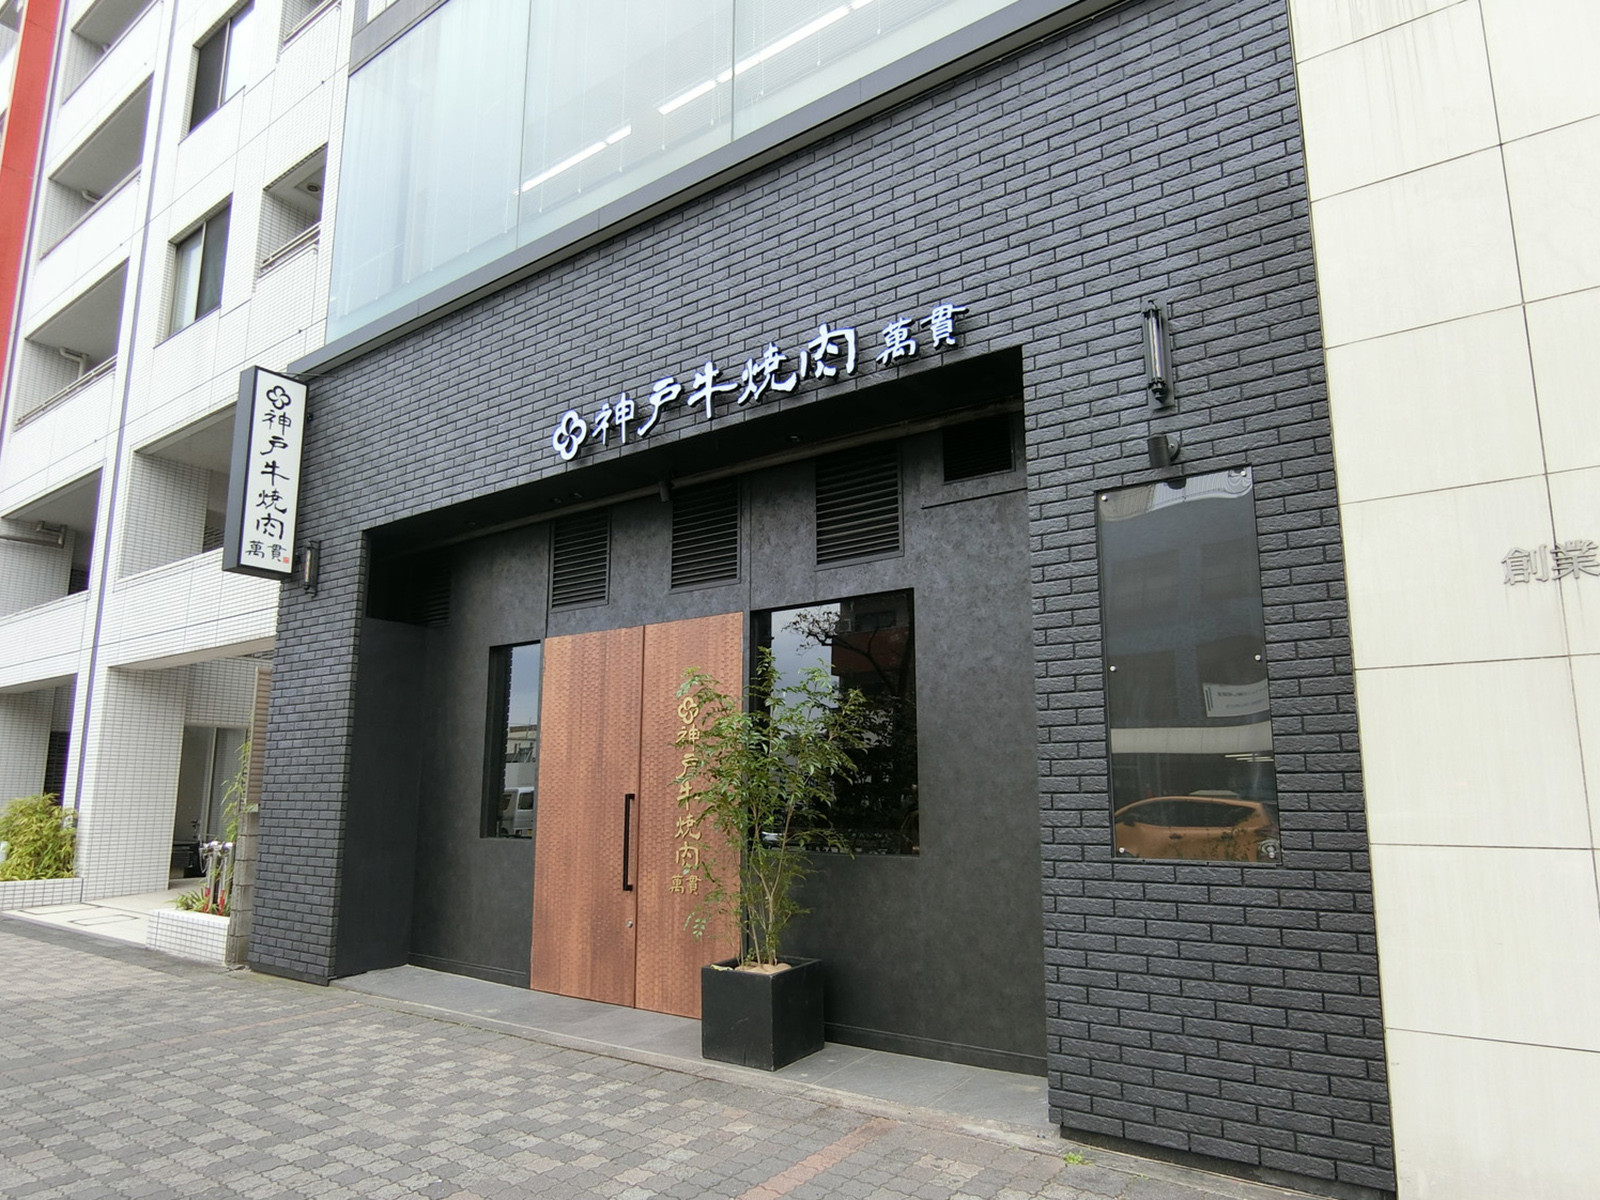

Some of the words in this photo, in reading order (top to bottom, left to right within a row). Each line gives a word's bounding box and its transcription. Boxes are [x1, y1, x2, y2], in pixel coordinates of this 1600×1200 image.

[591, 322, 857, 445] 神戸牛焼肉
[876, 303, 969, 366] 萬貫
[255, 410, 292, 540] 神戸牛焼肉
[245, 540, 288, 562] 萬貫
[1500, 540, 1600, 586] 創業
[674, 724, 702, 871] 神戸牛焼肉
[669, 874, 702, 895] 萬貫
